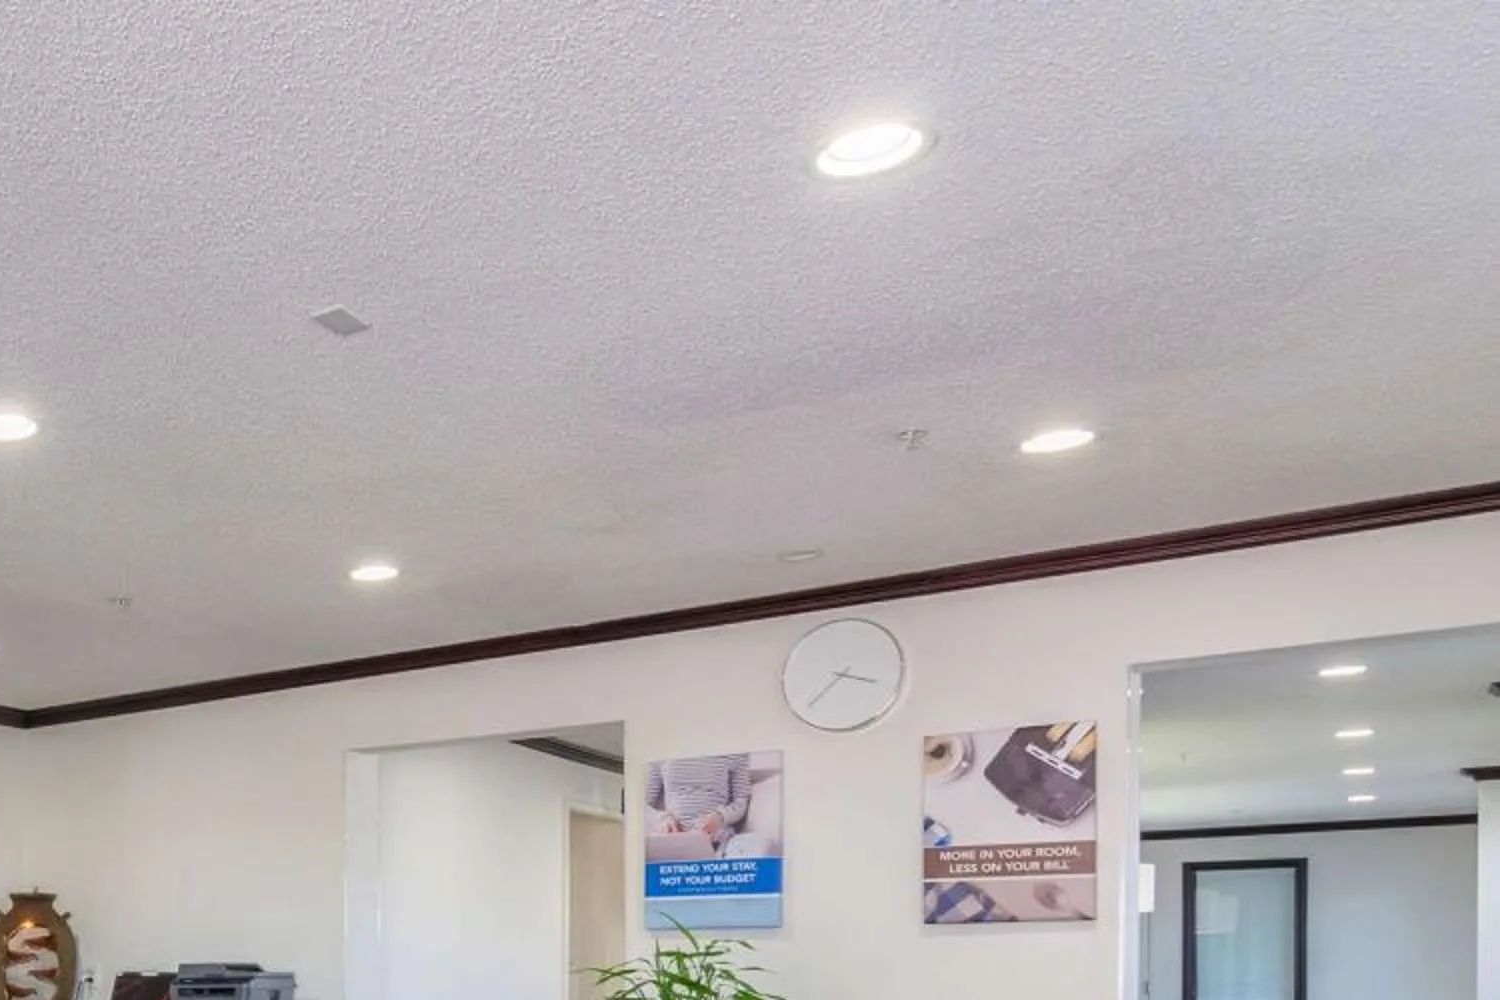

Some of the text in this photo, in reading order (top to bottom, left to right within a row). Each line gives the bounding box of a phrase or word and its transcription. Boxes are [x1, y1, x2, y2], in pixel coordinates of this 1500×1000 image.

[939, 850, 977, 861] MORE
[979, 849, 994, 860] IN
[997, 848, 1032, 859] YOUR
[659, 863, 700, 875] EXTEND
[702, 862, 730, 873] YOUR
[949, 863, 978, 874] LESS
[981, 862, 1002, 873] ON
[1005, 861, 1040, 872] YOUR
[660, 873, 756, 886] NOT YOUR BUDGET
